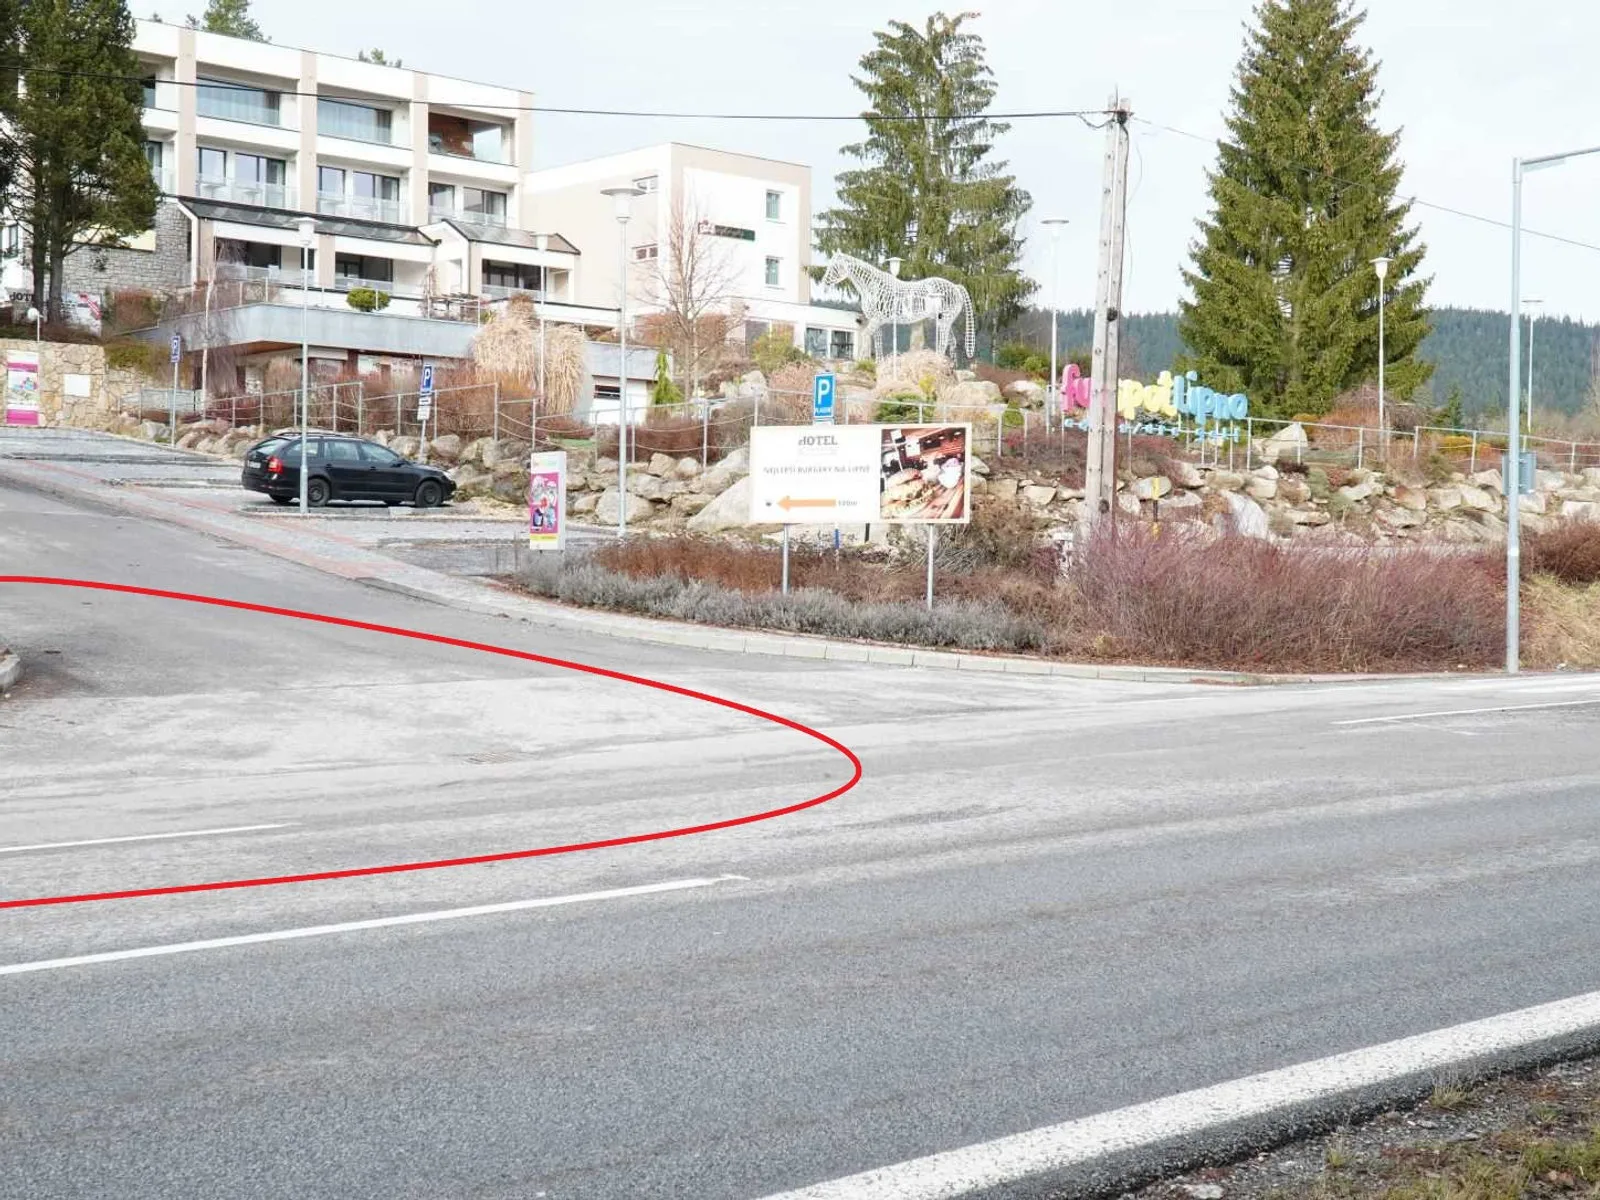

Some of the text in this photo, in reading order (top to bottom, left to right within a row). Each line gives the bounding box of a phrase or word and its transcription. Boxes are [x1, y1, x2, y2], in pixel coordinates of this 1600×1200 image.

[424, 369, 431, 386] P
[818, 380, 830, 404] P
[798, 435, 838, 446] HOTEL
